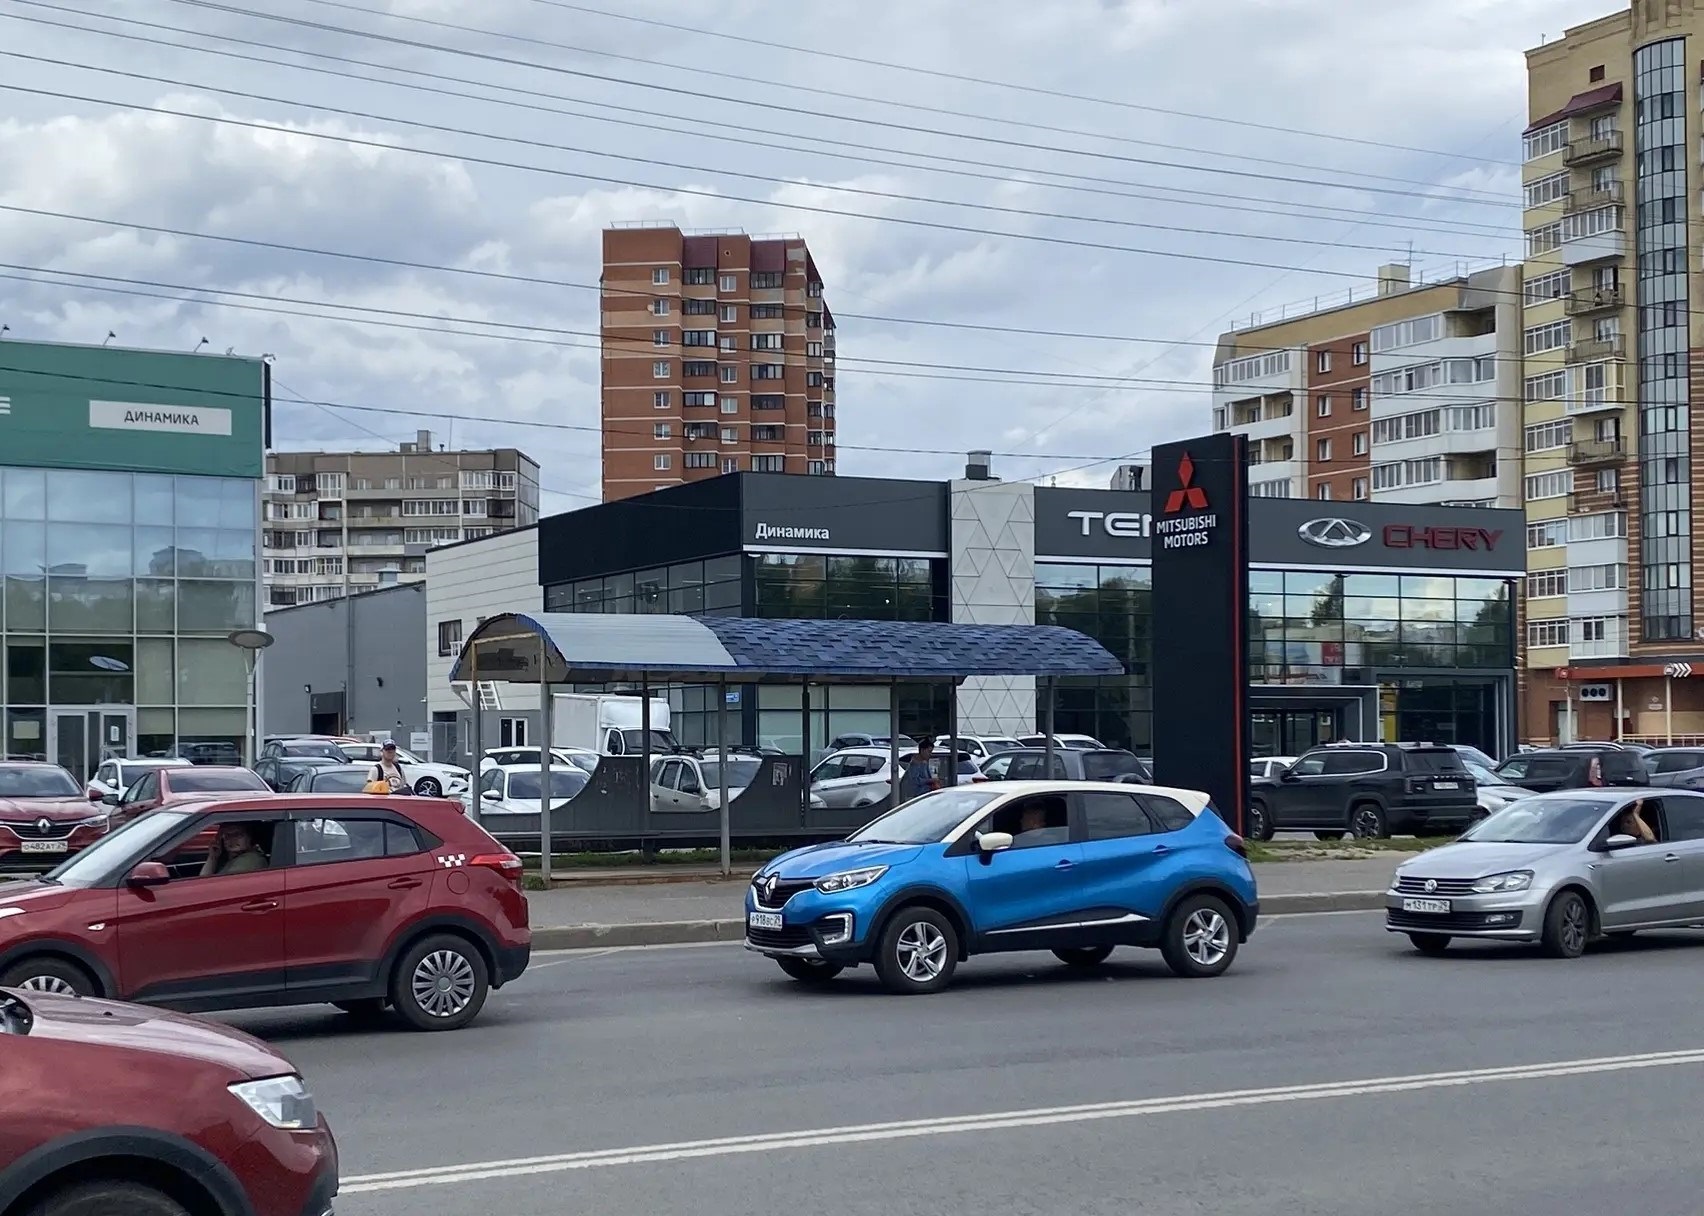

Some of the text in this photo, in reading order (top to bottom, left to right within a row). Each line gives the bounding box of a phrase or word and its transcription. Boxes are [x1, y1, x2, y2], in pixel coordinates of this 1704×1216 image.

[124, 411, 200, 426] ДИНАМИКА
[755, 523, 829, 539] Динамика
[1156, 514, 1216, 534] MITSUBISHI
[1164, 531, 1208, 549] MOTORS
[1383, 524, 1503, 551] CHERY
